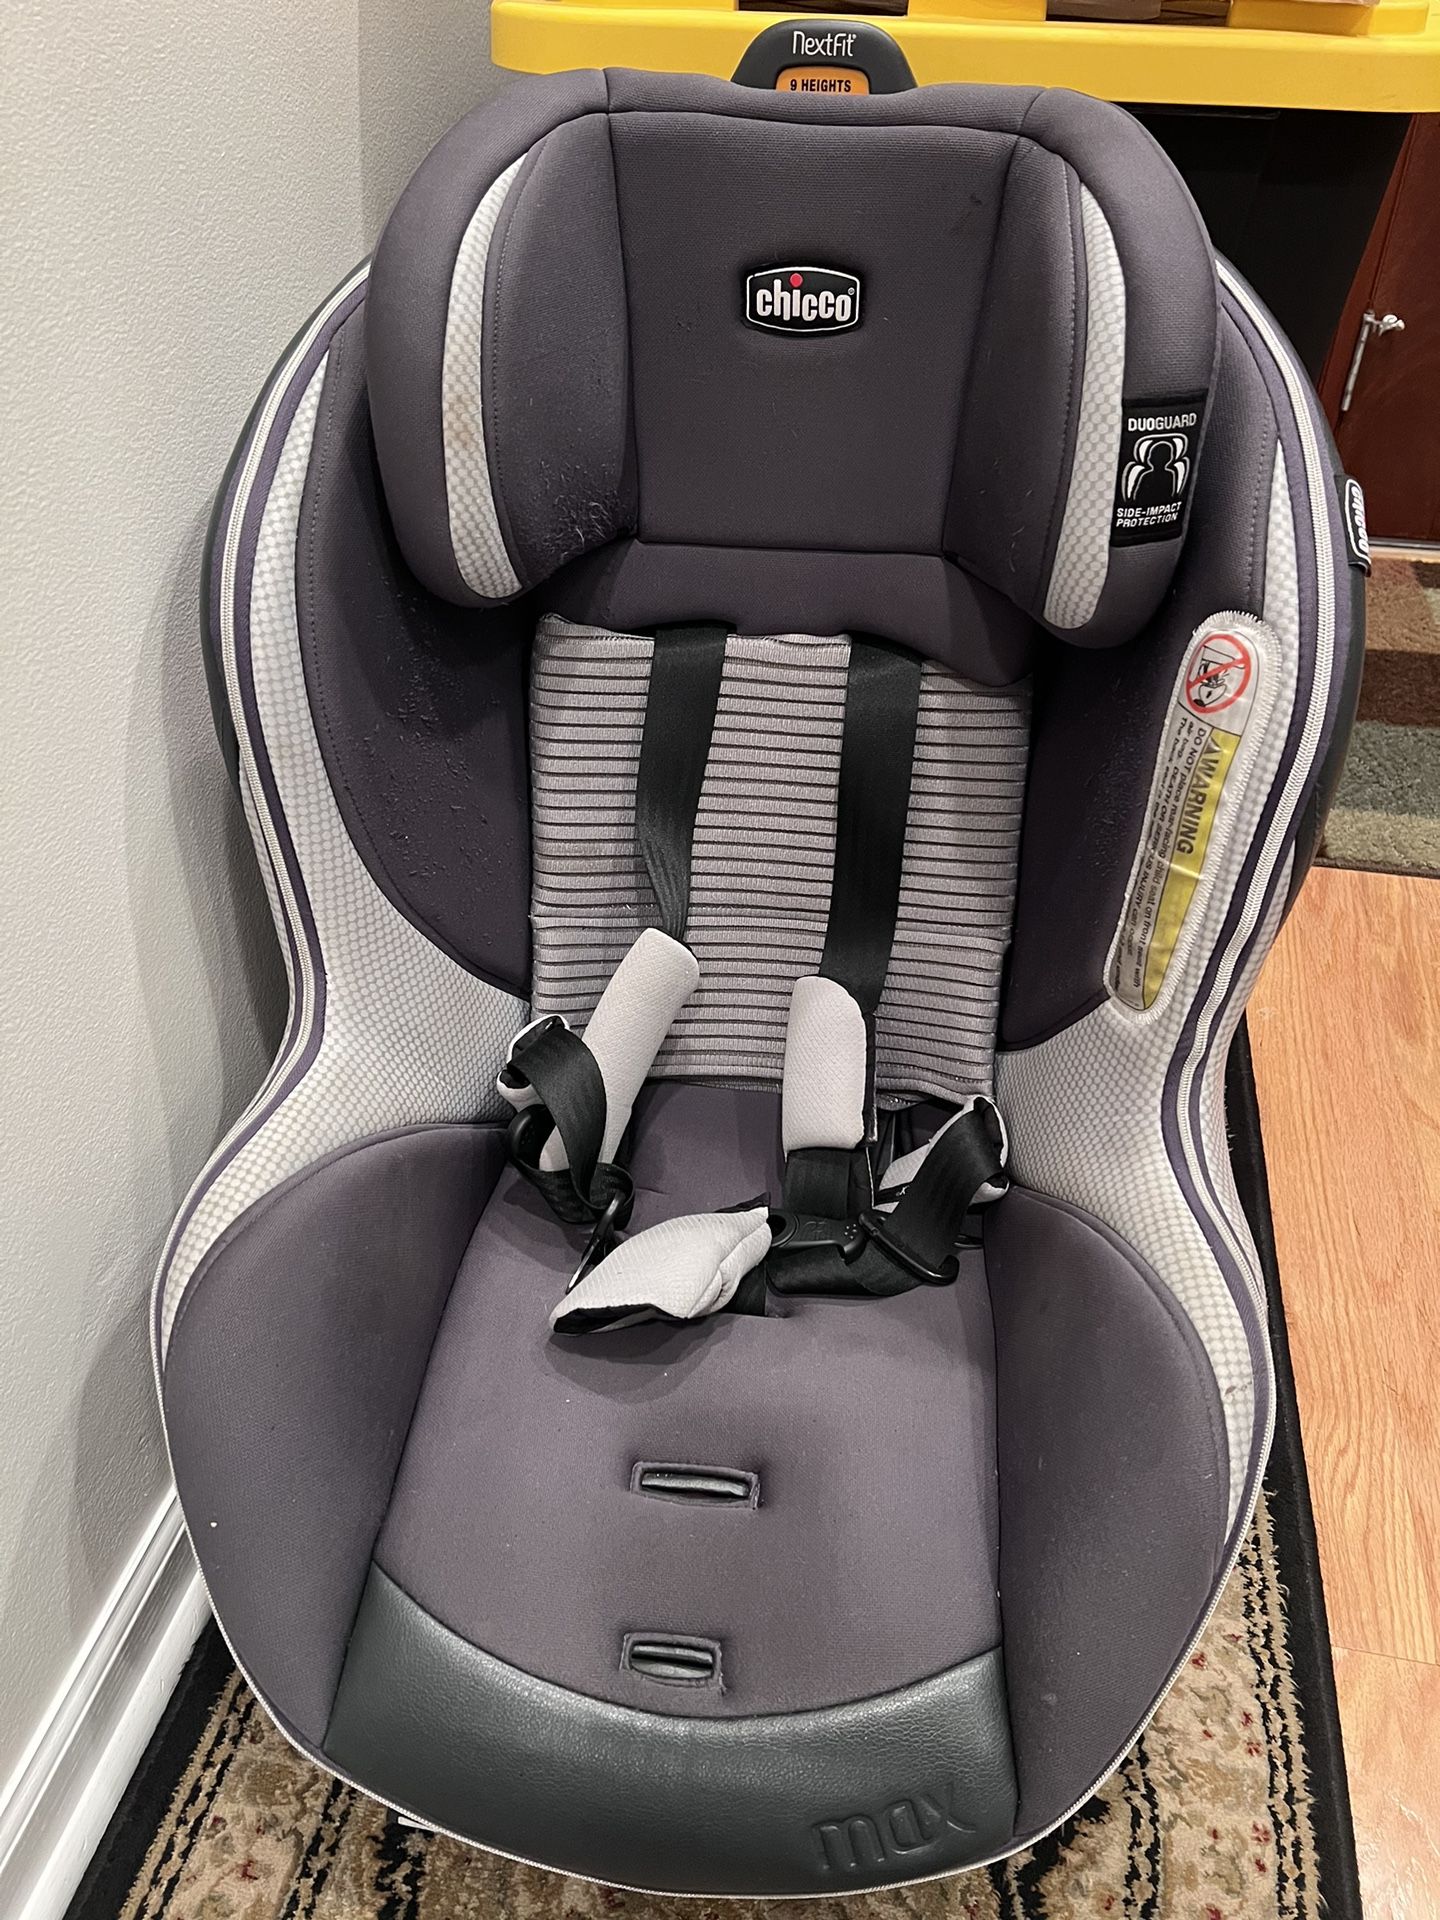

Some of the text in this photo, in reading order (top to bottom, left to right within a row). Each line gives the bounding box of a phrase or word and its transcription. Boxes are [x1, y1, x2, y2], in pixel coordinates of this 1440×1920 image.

[790, 79, 852, 93] 9 HEIGHTS
[756, 273, 852, 322] chicco
[1128, 413, 1197, 431] DUOGUARD
[1116, 501, 1182, 518] SIDE-IMPACT
[1116, 512, 1178, 528] PROTECTION
[1194, 727, 1206, 745] DO
[1184, 747, 1198, 773] NOT
[1164, 766, 1179, 804] DEATH
[1173, 772, 1187, 802] place
[1175, 758, 1219, 855] WARNING
[1152, 859, 1164, 884] child
[1134, 870, 1149, 908] INJURY
[1147, 884, 1158, 905] seat
[1143, 905, 1152, 918] on
[1138, 920, 1151, 944] front
[1132, 967, 1140, 987] with
